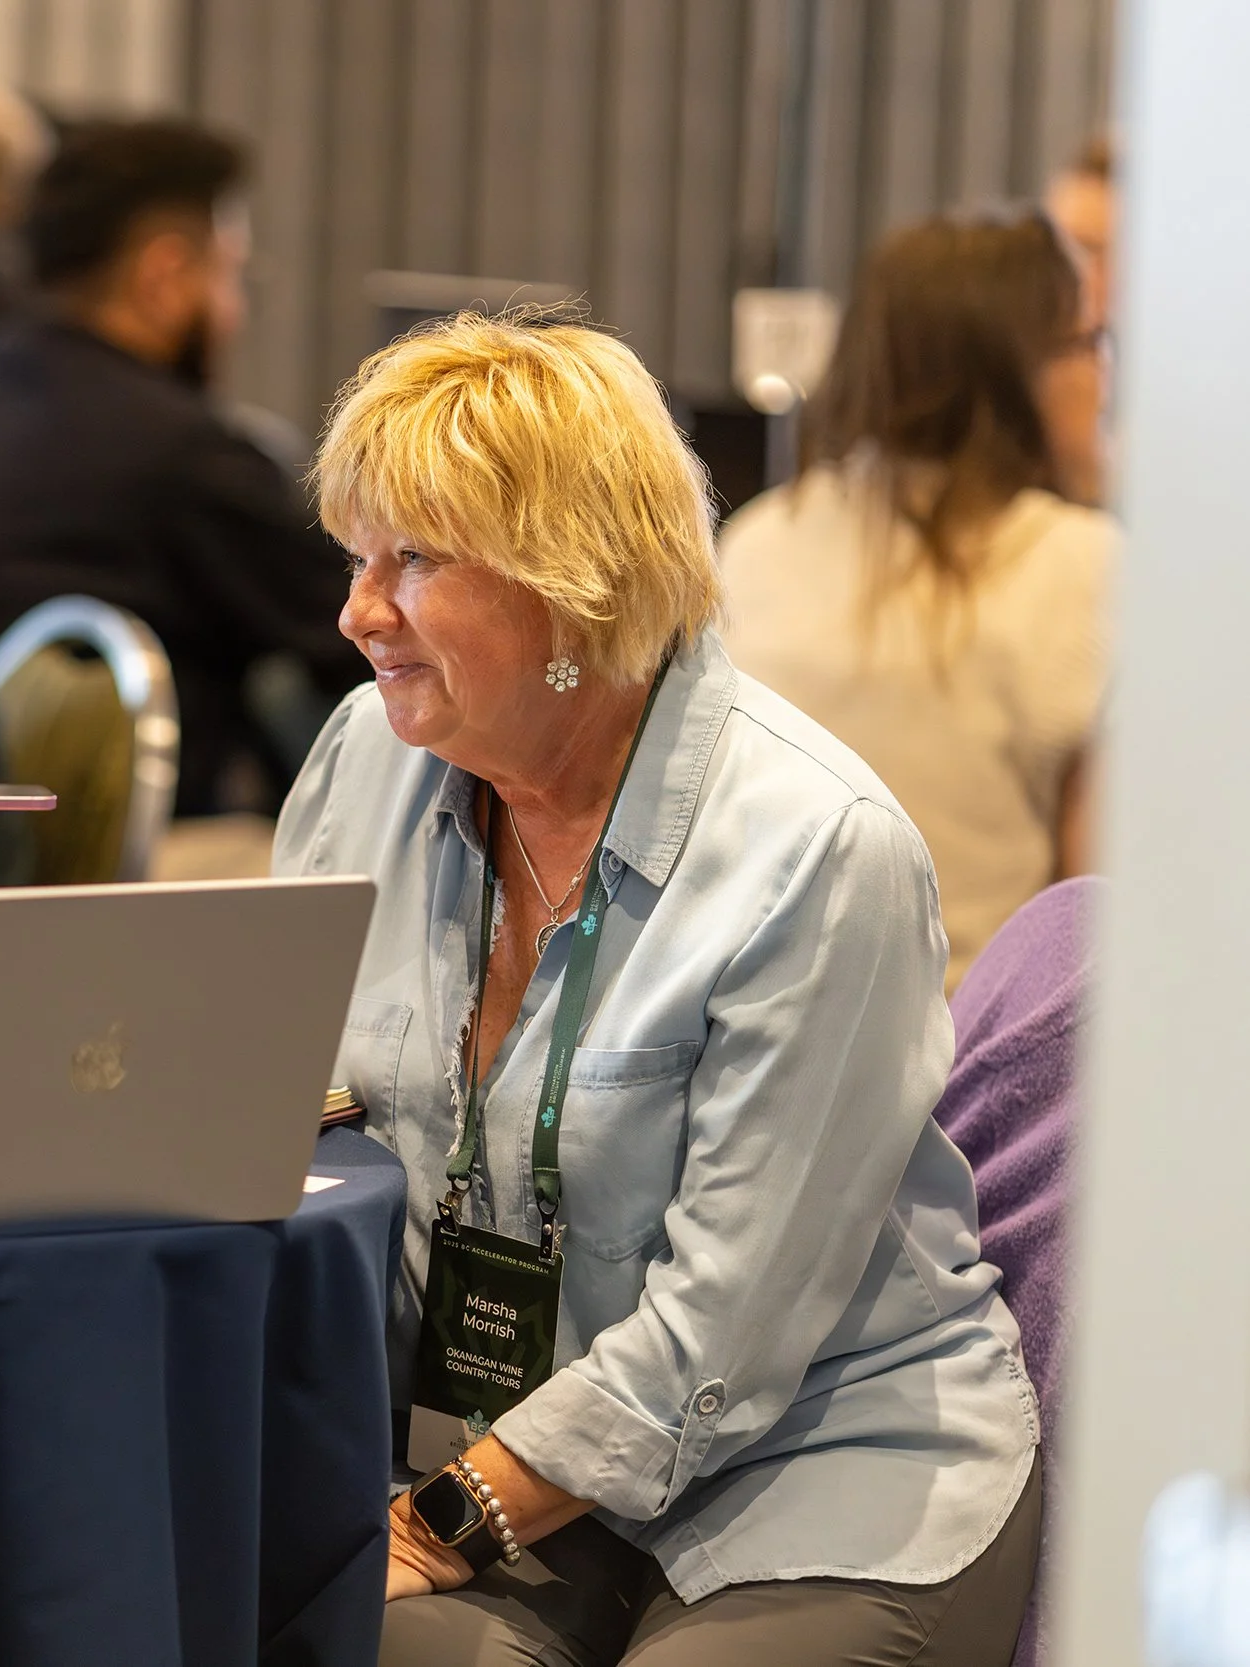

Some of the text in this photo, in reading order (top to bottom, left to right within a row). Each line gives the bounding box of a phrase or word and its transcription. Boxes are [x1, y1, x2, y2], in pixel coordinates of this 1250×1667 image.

[461, 1243, 470, 1252] BC
[471, 1247, 517, 1265] ACCELERATOR
[518, 1260, 549, 1274] PROGRAM
[466, 1293, 517, 1320] Marsha
[463, 1312, 516, 1340] Morrish
[446, 1347, 524, 1378] OKANAGAN WINE
[446, 1360, 521, 1390] COUNTRY TOURS
[470, 1421, 485, 1434] BC
